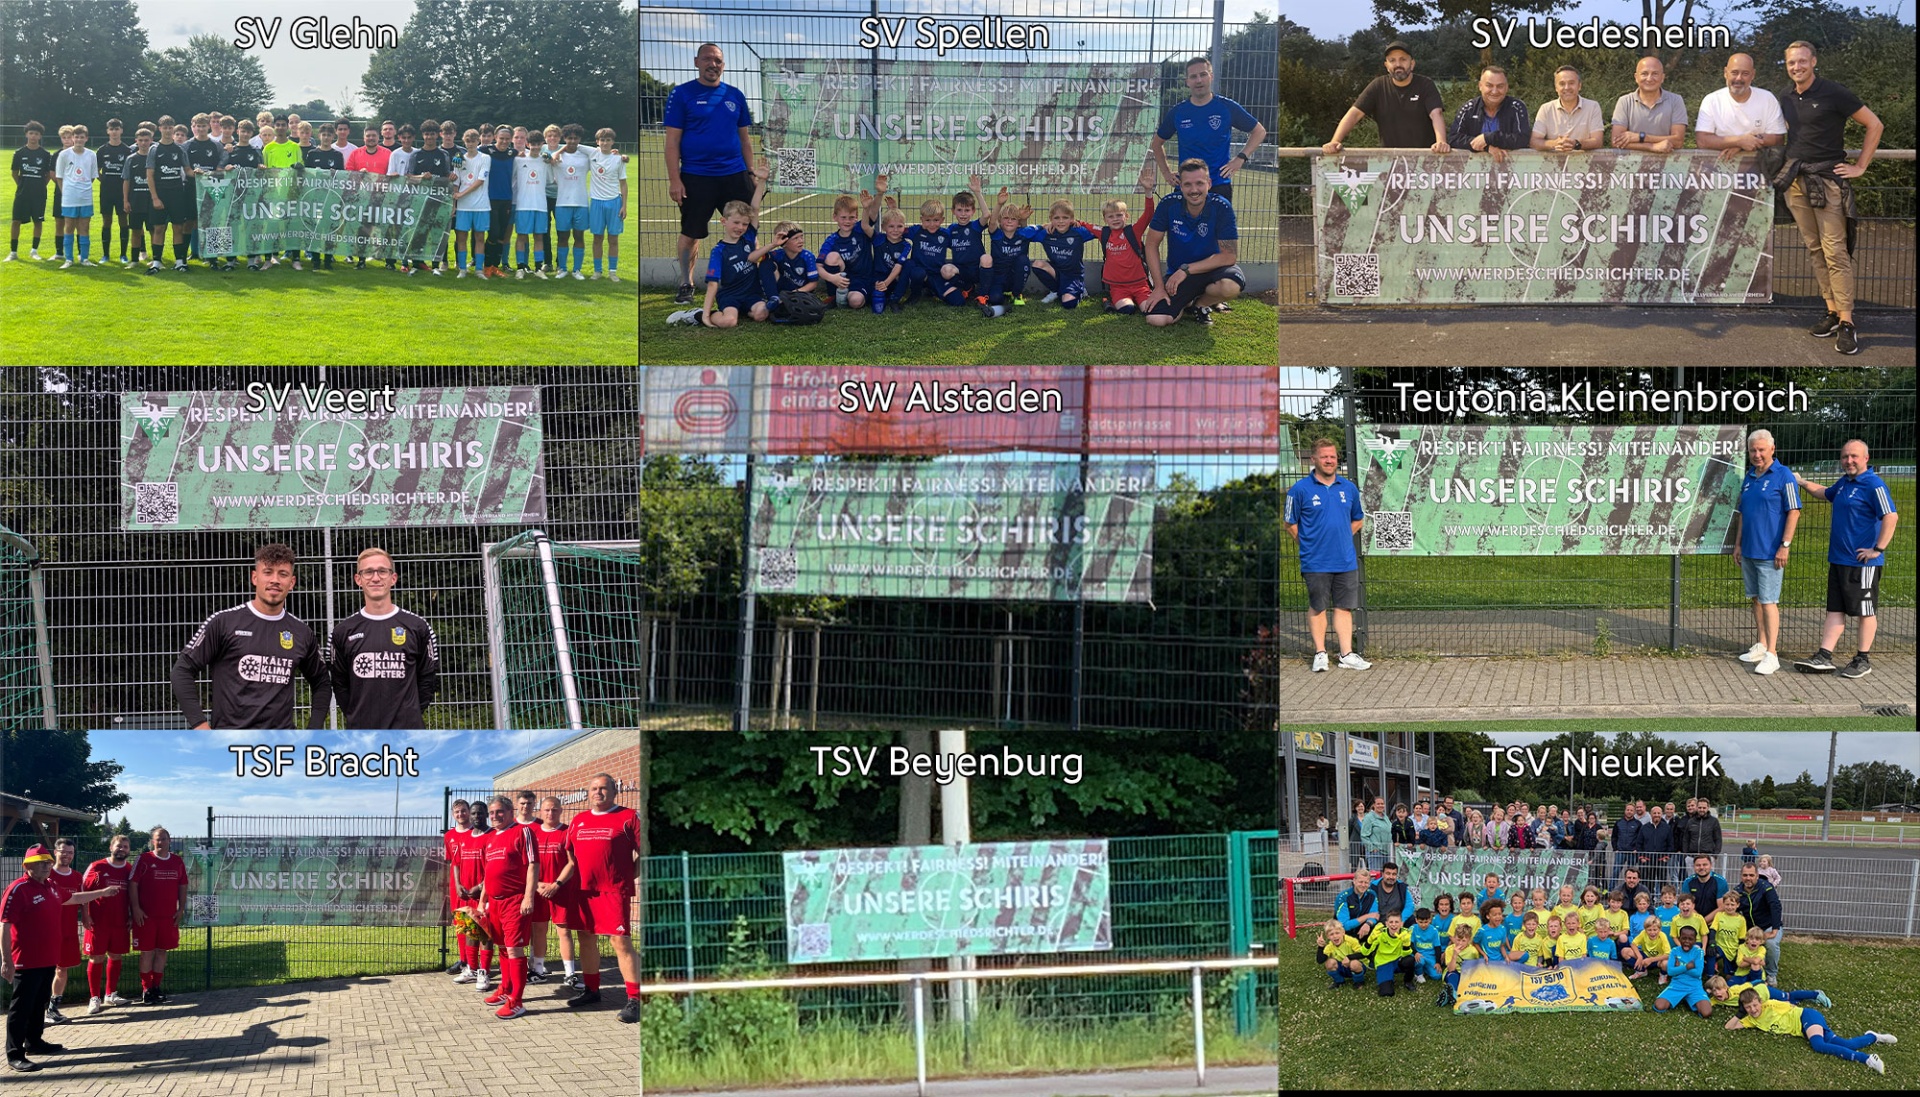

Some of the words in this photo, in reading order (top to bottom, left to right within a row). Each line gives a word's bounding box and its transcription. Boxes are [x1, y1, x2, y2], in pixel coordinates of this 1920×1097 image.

[825, 75, 915, 93] RESPEKT!
[919, 76, 1013, 93] FAIRNESS!
[1019, 77, 1154, 94] MITEINANDER!
[833, 113, 965, 142] UNSERE
[976, 114, 1105, 142] SCHIRIS
[848, 162, 1088, 176] WWW.WERDESCHIEDSRICHTER.DE
[237, 177, 293, 188] RESPEKT!
[296, 177, 357, 190] FAIRNESS!
[359, 182, 449, 196] MITEINANDER!
[1391, 172, 1490, 190] RESPEKT!
[1497, 173, 1602, 190] FAIRNESS!
[1609, 173, 1766, 190] MITEINANDER!
[241, 200, 324, 220] UNSERE
[329, 203, 416, 226] SCHIRIS
[1400, 214, 1549, 244] UNSERE
[1560, 214, 1709, 244] SCHIRIS
[251, 231, 404, 247] WWW.WERDESCHIEDSRICHTER.DE
[1416, 267, 1691, 281] WWW.WERDESCHIEDSRICHTER.DE
[783, 370, 838, 392] Erfolg
[781, 390, 842, 408] einfac
[392, 402, 533, 420] MITEINANDER!
[1420, 441, 1506, 456] RESPEKT!
[1512, 441, 1602, 456] FAIRNESS!
[1608, 440, 1739, 456] MITEINANDER!
[198, 444, 337, 473] UNSERE
[347, 440, 484, 471] SCHIRIS
[813, 477, 896, 492] RESPEKT!
[902, 477, 995, 493] FAIRNESS!
[1002, 478, 1146, 493] MITEINANDER!
[1429, 478, 1557, 504] UNSERE
[1567, 478, 1692, 503] SCHIRIS
[213, 491, 470, 508] WWW.WERDESCHIEDSRICHTER.DE
[817, 514, 945, 542] UNSERE
[957, 516, 1091, 544] SCHIRIS
[1444, 525, 1676, 536] WWW.WERDESCHIEDSRICHTER.DE
[262, 656, 293, 668] KÄLTE
[375, 651, 406, 661] KÄLTE
[261, 664, 291, 676] KLIMA
[375, 661, 406, 670] KLIMA
[260, 674, 290, 685] PETERS
[375, 670, 406, 679] PETERS
[227, 847, 285, 858] RESPEKT!
[288, 847, 351, 858] FAIRNESS!
[355, 847, 446, 858] MITEINANDER
[1425, 853, 1467, 862] RESPEKT!
[1469, 854, 1515, 864] FAIRNESS!
[1517, 856, 1586, 866] MITEINANDER!
[837, 860, 908, 875] RESPEKT!
[912, 858, 988, 872] FAIRNESS!
[992, 853, 1103, 869] MITEINANDER!
[231, 871, 319, 890] UNSERE
[326, 871, 415, 890] SCHIRIS
[1498, 874, 1560, 890] SCHIRIS
[844, 889, 951, 915] UNSERE
[959, 885, 1065, 910] SCHIRIS
[1468, 982, 1497, 990] JUGEND
[1530, 976, 1543, 984] TSV
[1544, 972, 1564, 984] 95/10
[1589, 974, 1619, 983] ZUKUNF
